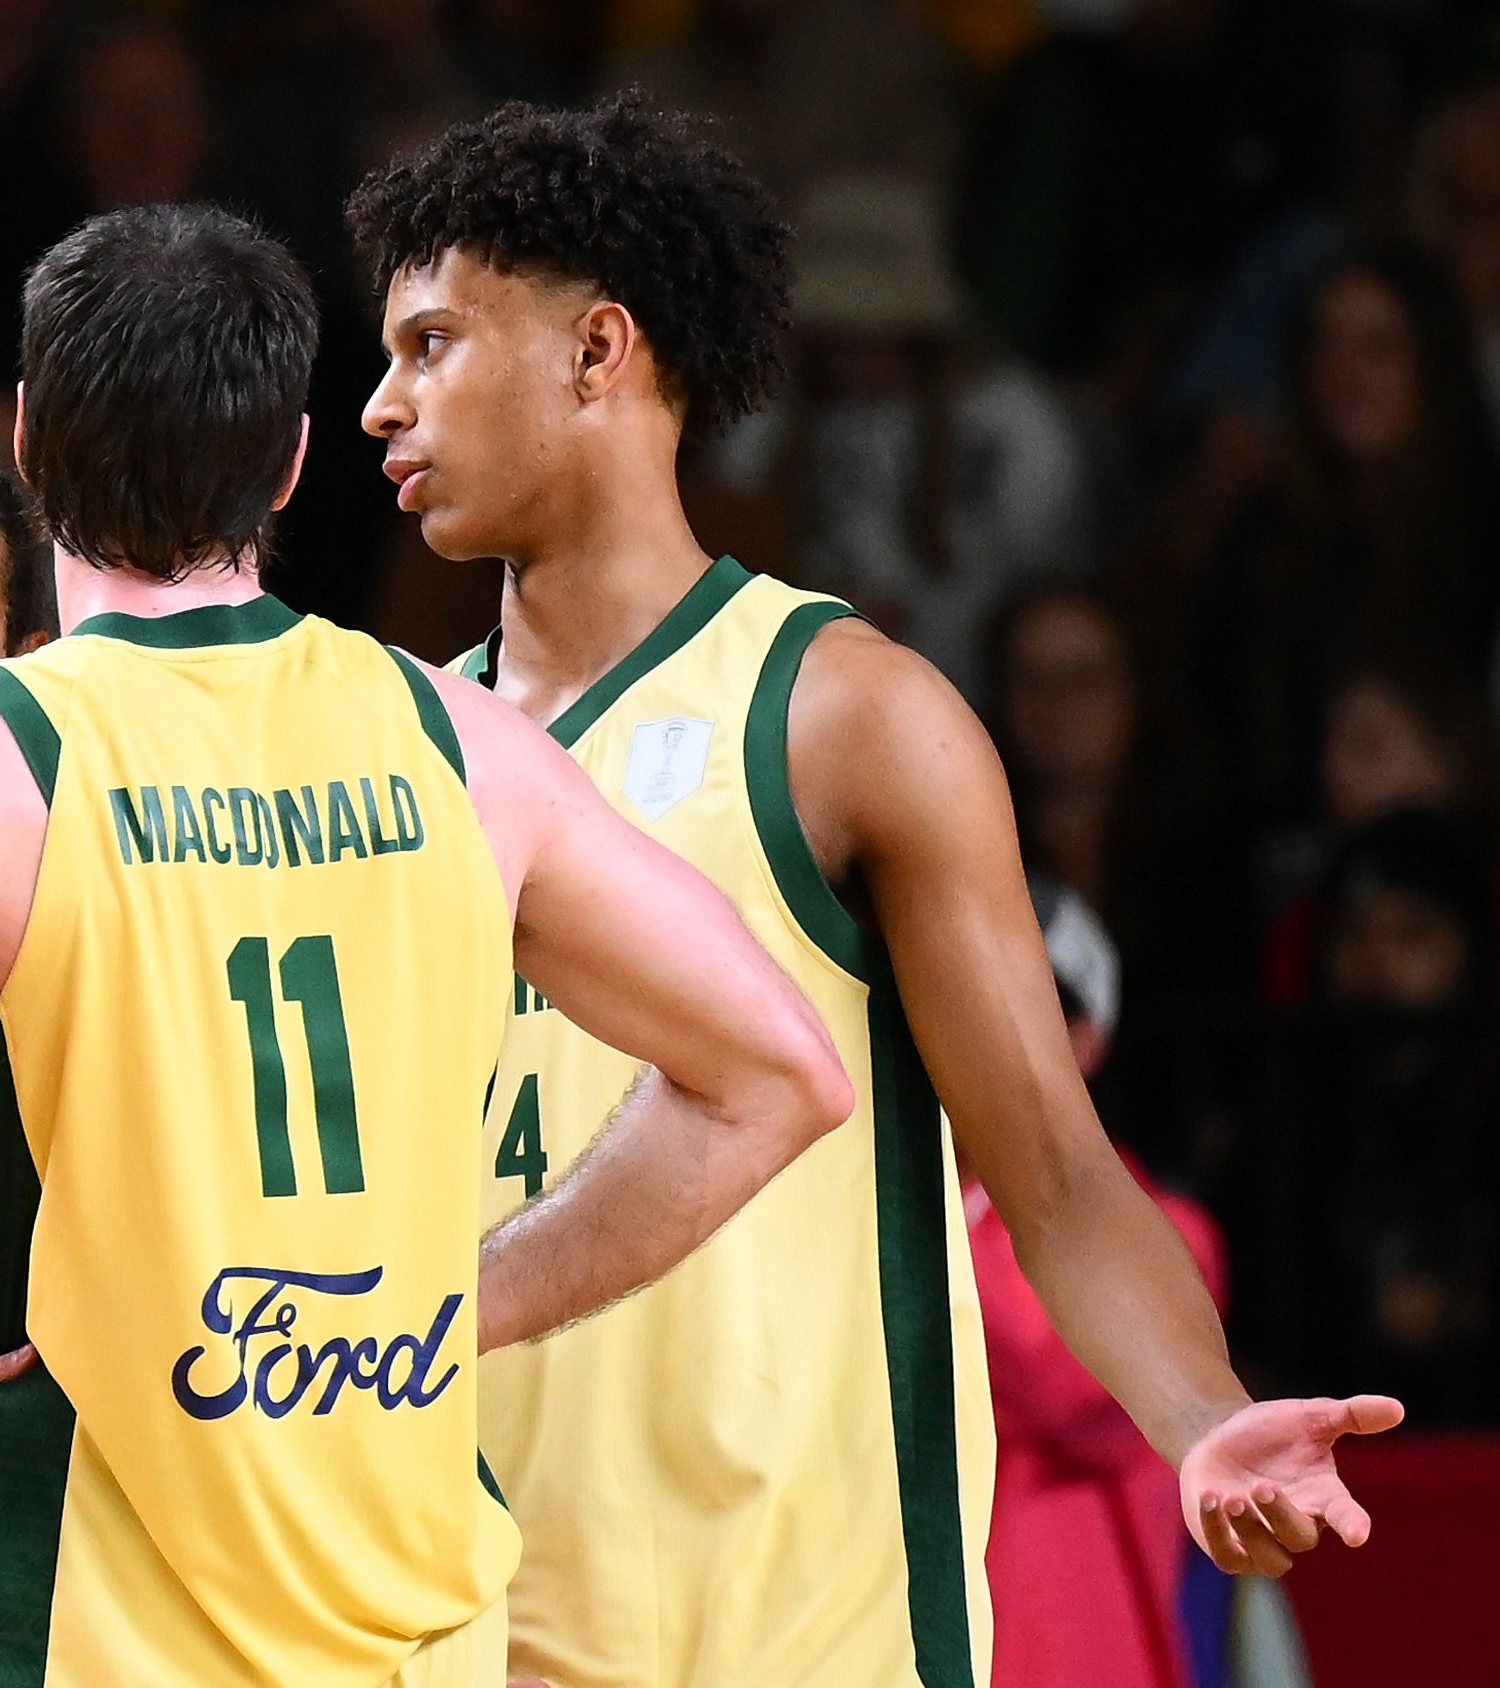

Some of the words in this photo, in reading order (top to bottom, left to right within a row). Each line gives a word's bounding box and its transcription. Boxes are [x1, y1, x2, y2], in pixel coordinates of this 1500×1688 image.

[108, 774, 424, 869] MACDONALD
[226, 935, 365, 1197] 11
[495, 1073, 548, 1199] 4
[171, 1265, 464, 1419] Ford
